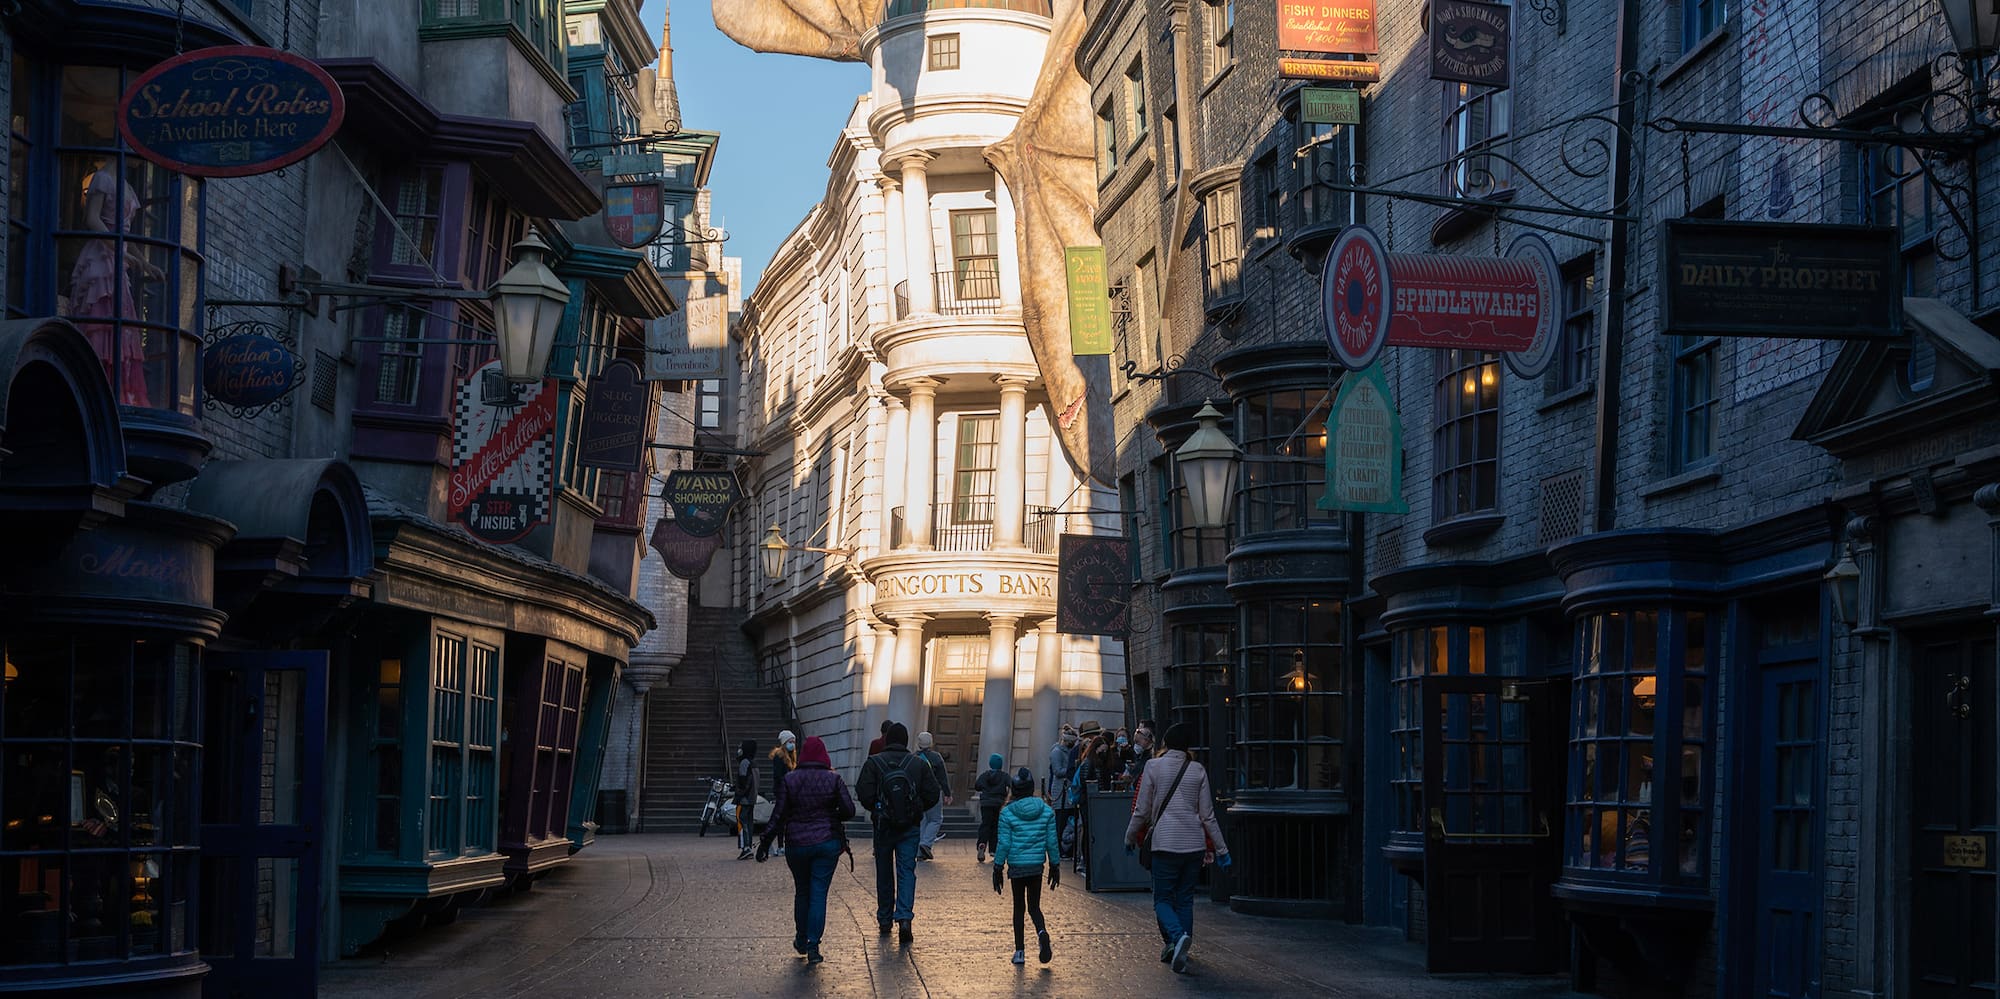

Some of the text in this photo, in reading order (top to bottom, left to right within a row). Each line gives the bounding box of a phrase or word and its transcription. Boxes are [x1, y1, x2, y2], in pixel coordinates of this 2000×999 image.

[1284, 4, 1370, 20] FISHY DINNERS
[1285, 18, 1332, 32] Established
[1315, 34, 1335, 43] 400
[1284, 62, 1374, 77] BREWS STEWS
[130, 82, 329, 119] School Robes
[159, 118, 297, 141] Available Here
[1337, 245, 1378, 297] FANCY YARNS
[1679, 263, 1881, 291] DAILY PROPHET
[1395, 287, 1537, 318] SPINDLEWARPS
[1339, 311, 1373, 350] BUTTONS
[208, 340, 284, 367] Madam
[602, 390, 633, 402] SLUG
[452, 404, 553, 507] Shutterbutton's
[675, 475, 731, 490] WAND
[486, 501, 512, 515] STEP
[674, 493, 731, 504] SHOWROOM
[480, 515, 517, 530] INSIDE
[878, 573, 1052, 599] GRINGOTTS BANK
